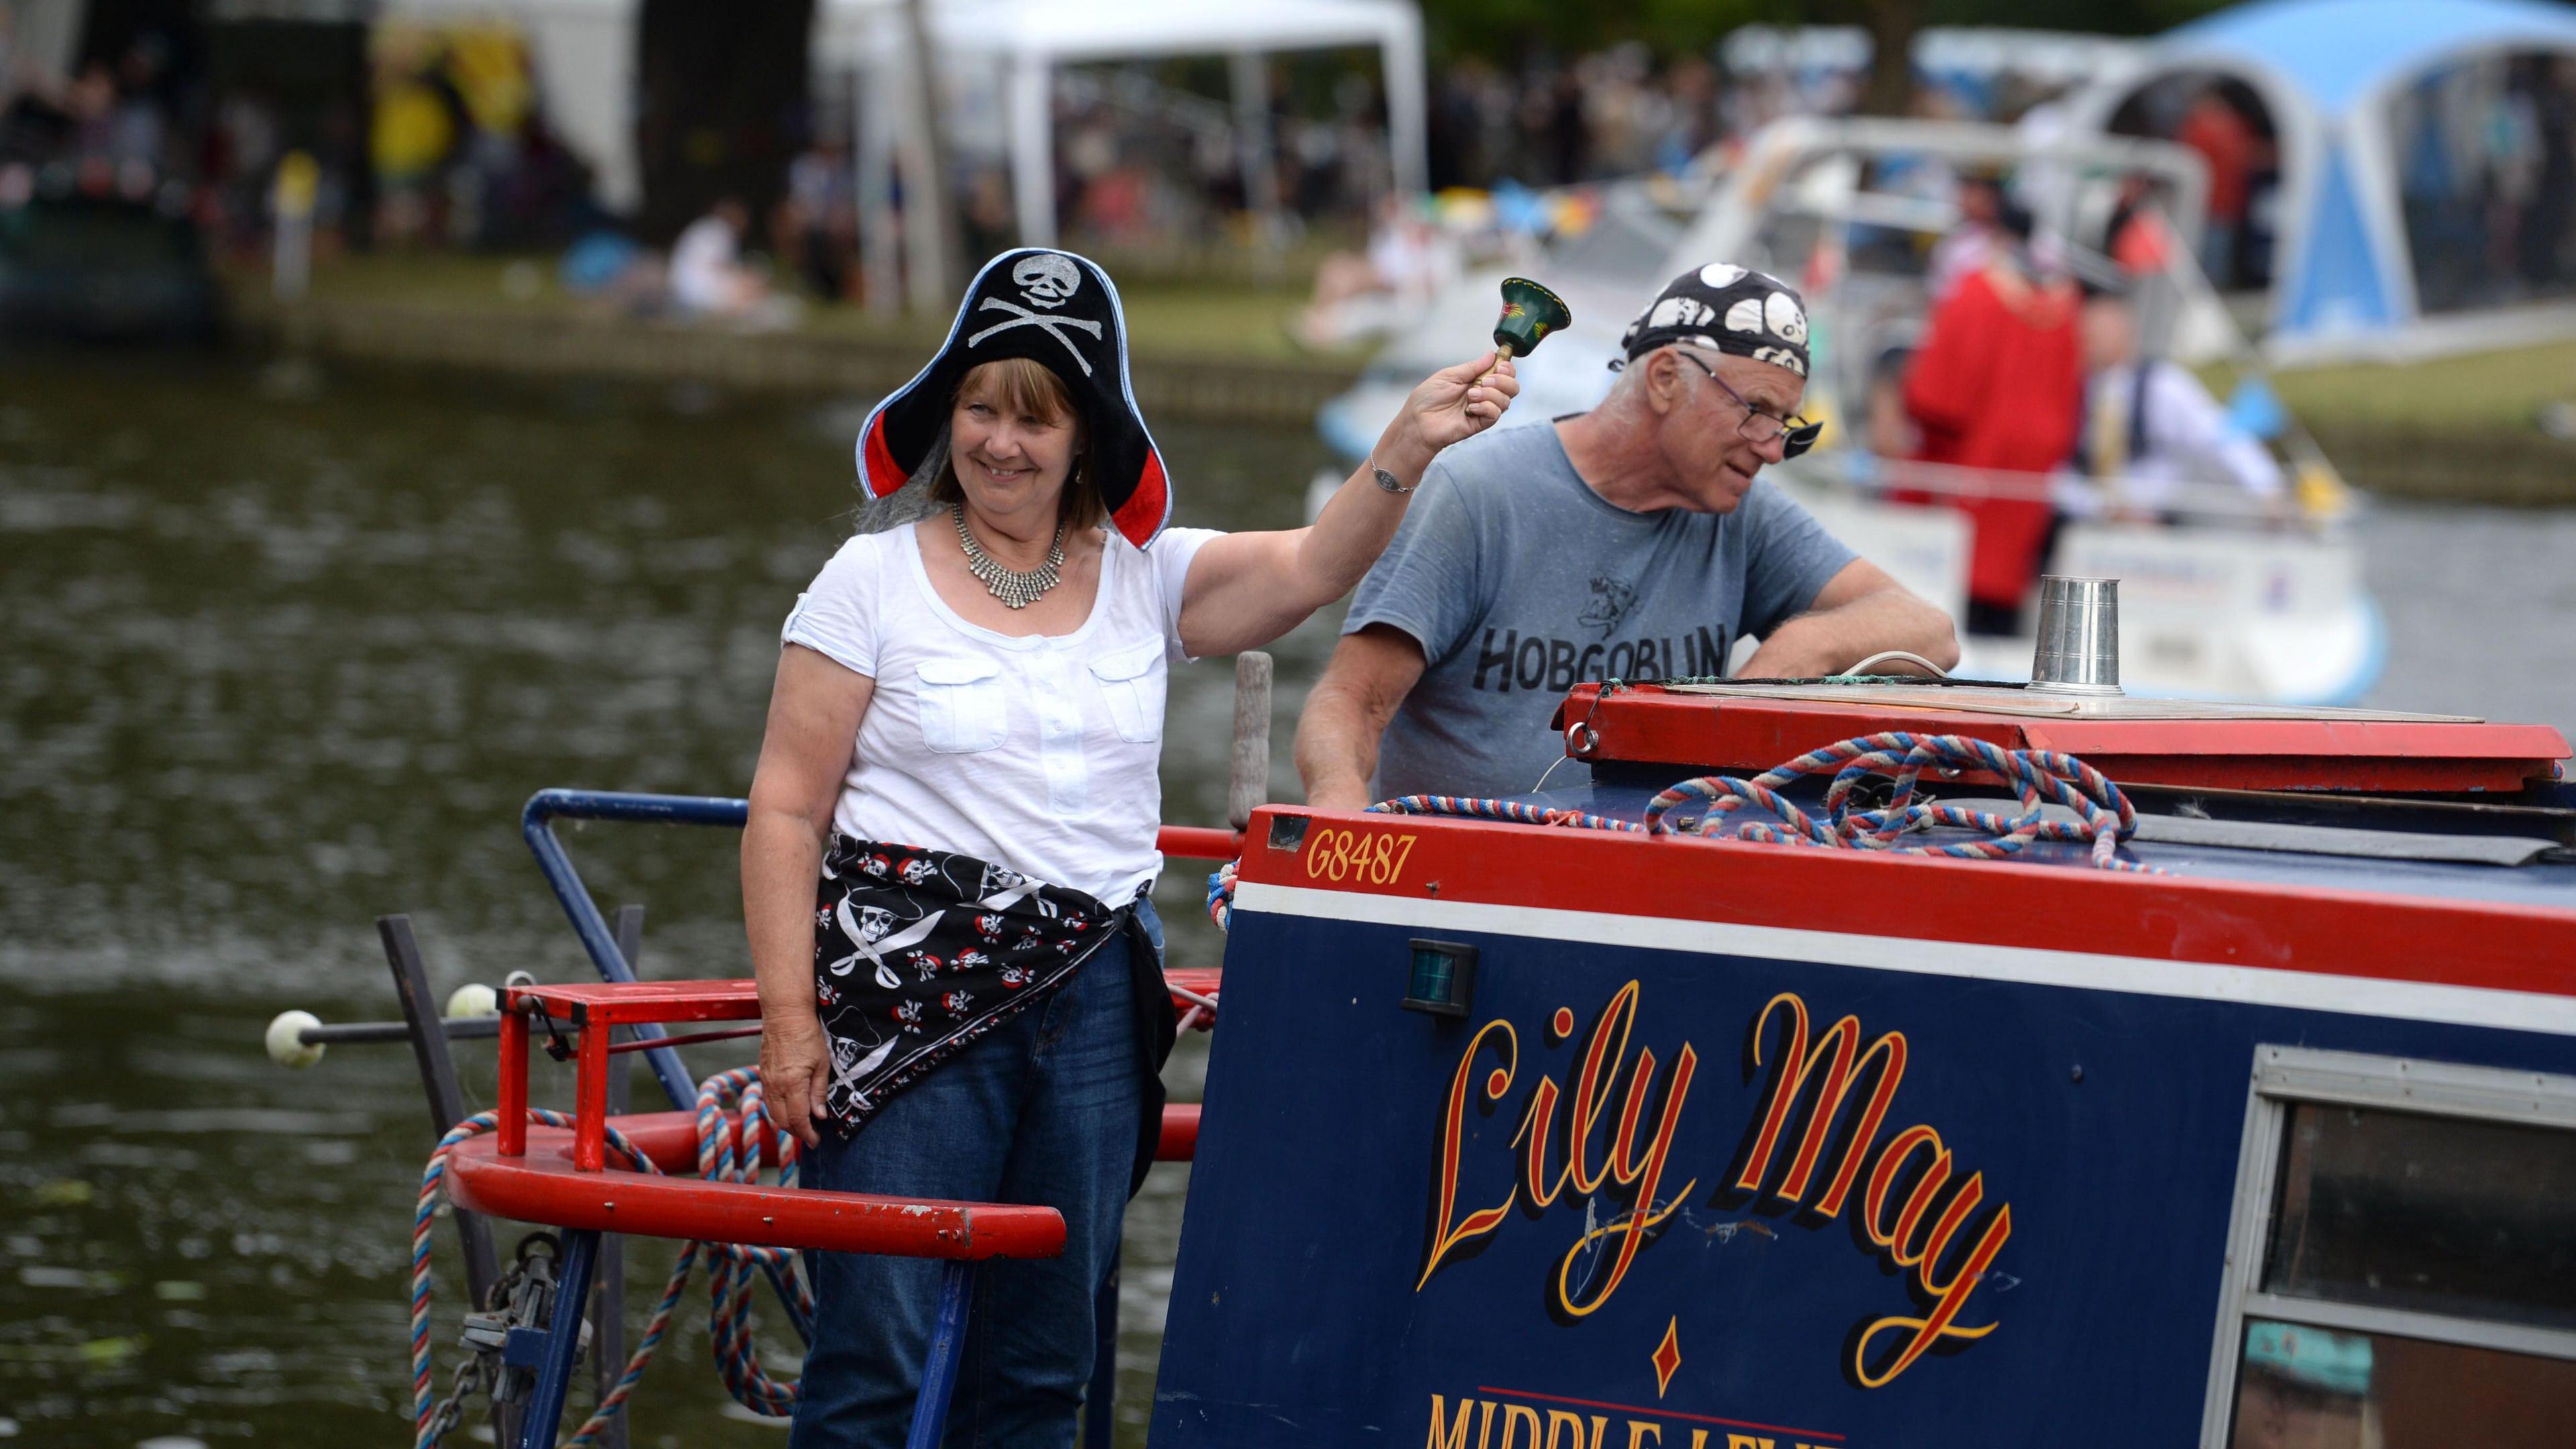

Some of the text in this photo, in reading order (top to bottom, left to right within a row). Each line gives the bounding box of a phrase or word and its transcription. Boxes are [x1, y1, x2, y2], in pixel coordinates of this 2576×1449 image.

[1472, 623, 1726, 693] HOBGOBLIN
[1307, 828, 1417, 885] G8487
[1414, 979, 2012, 1389] Lily May
